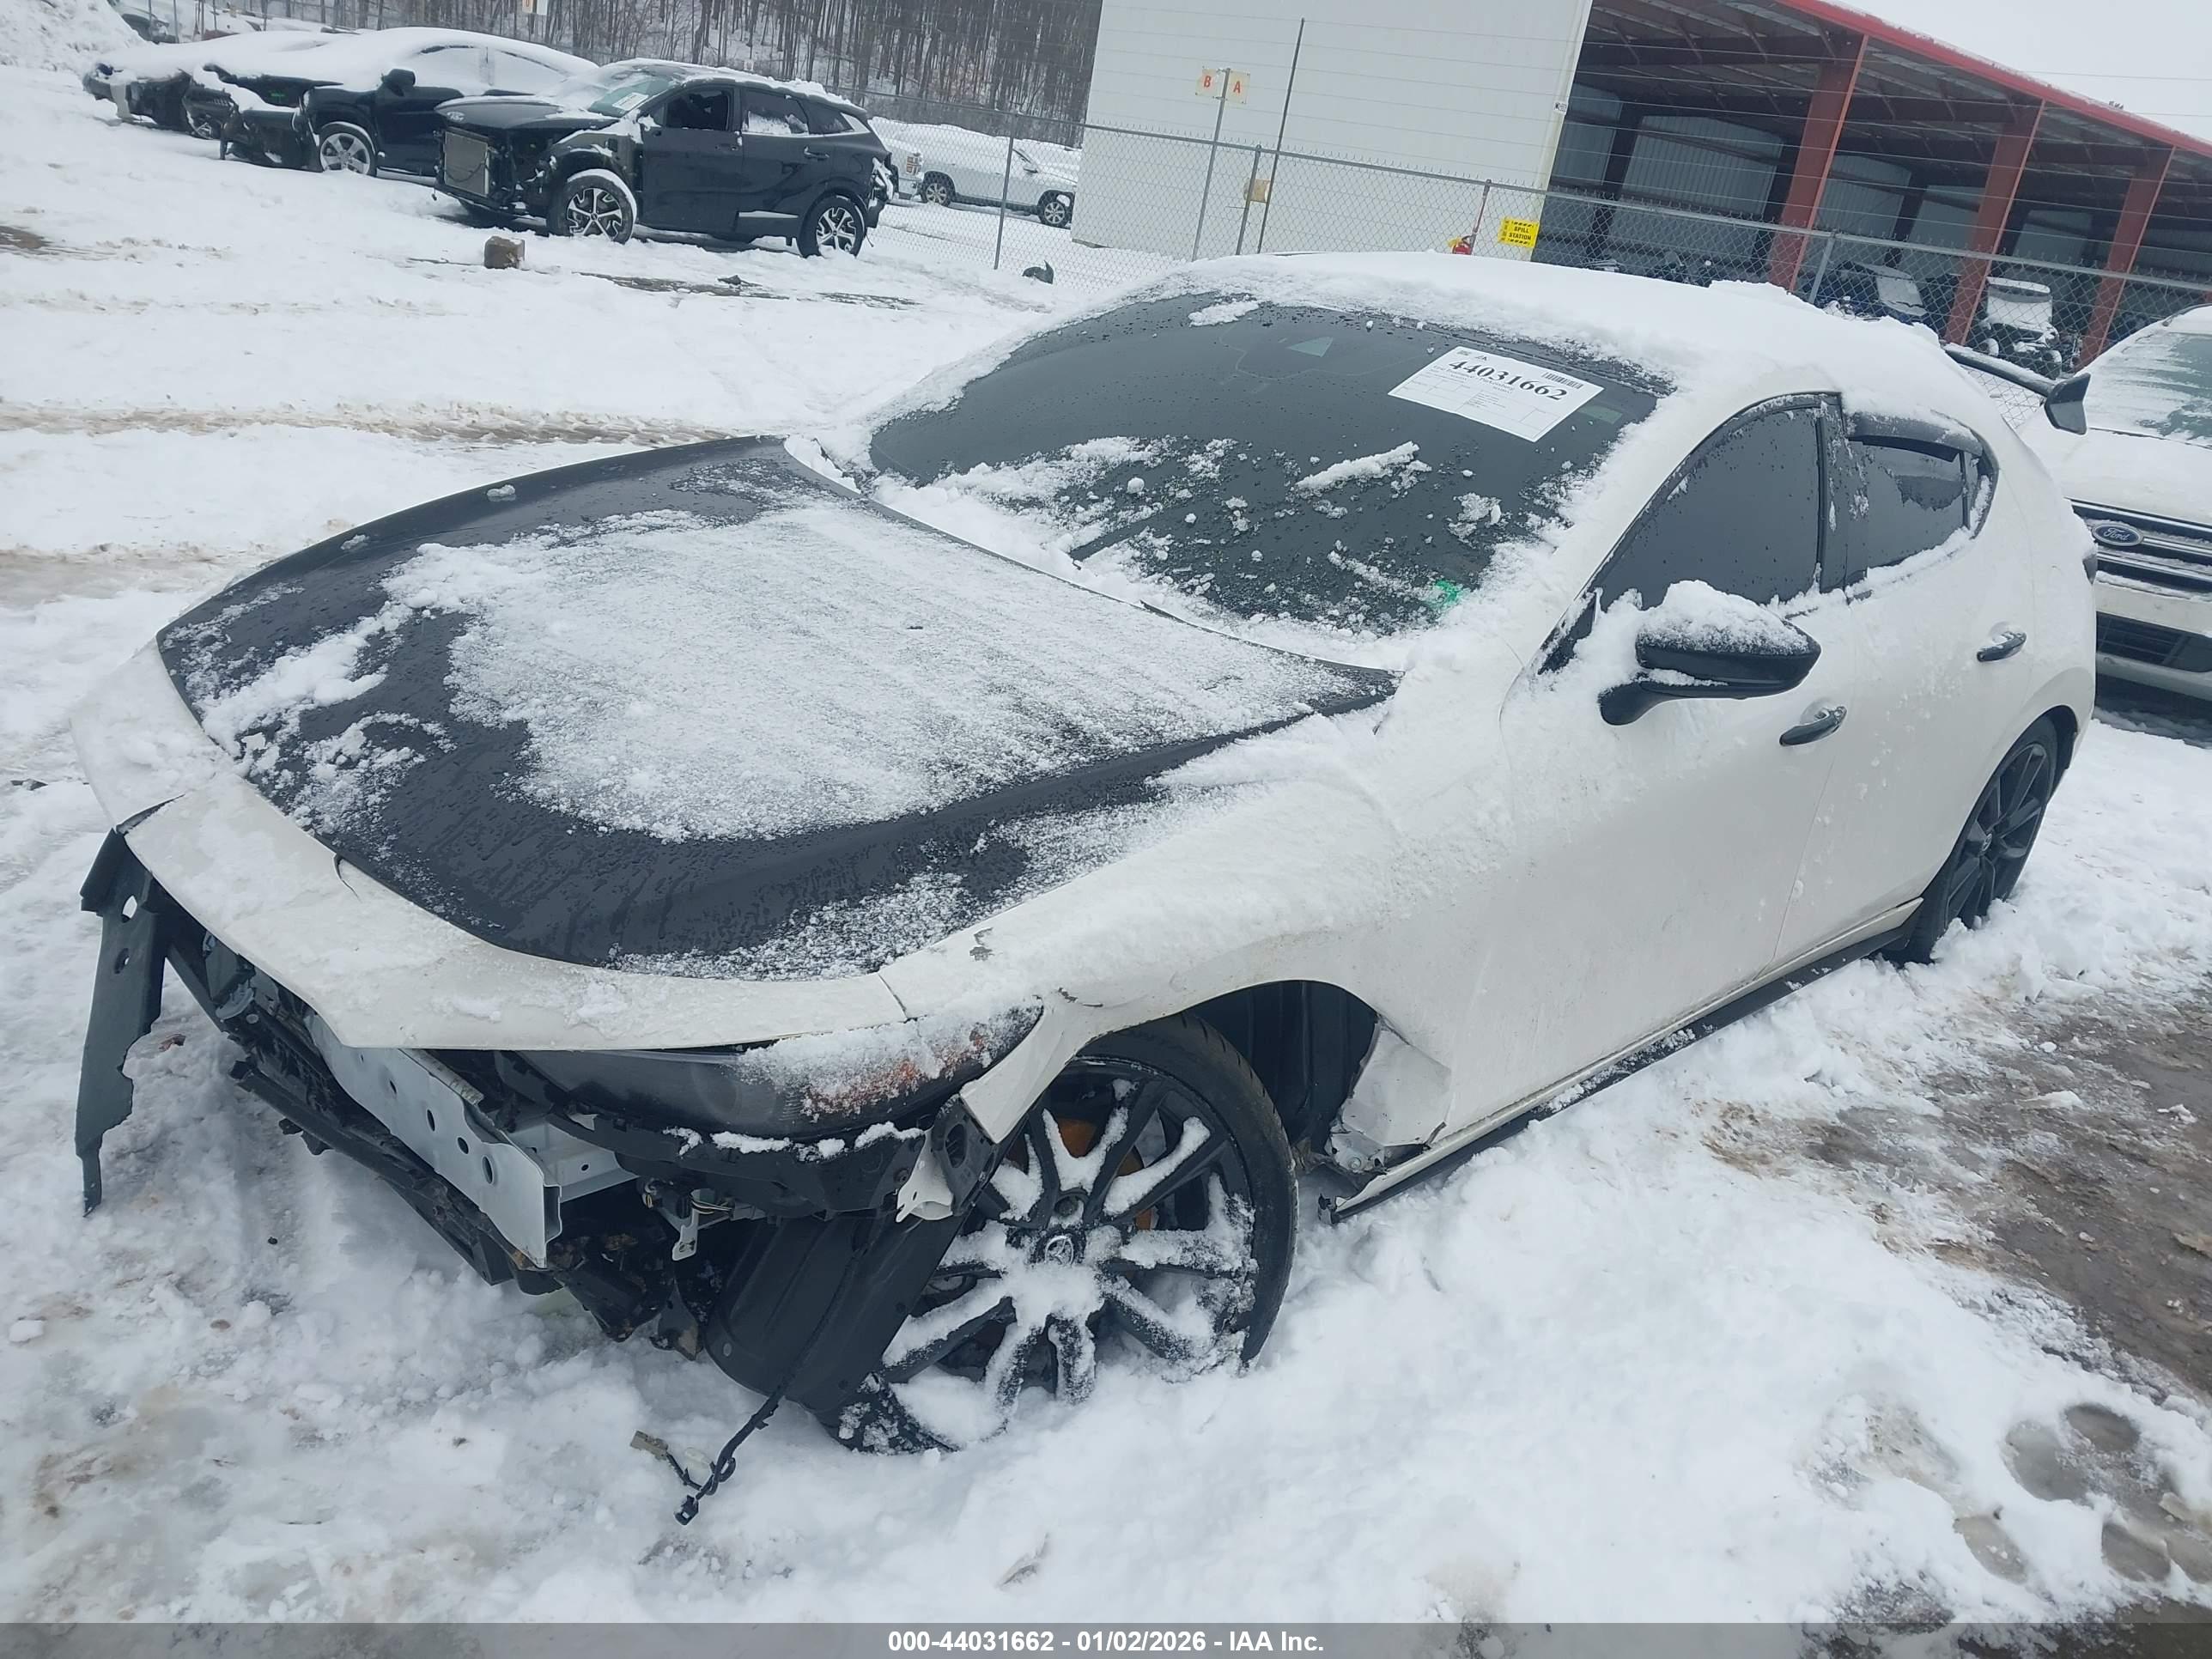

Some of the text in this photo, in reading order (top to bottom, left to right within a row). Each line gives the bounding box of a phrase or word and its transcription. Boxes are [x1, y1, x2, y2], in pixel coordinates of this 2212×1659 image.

[1204, 76, 1212, 88] B
[1233, 81, 1241, 94] A
[1509, 232, 1532, 240] STATION
[1449, 360, 1568, 400] 44031662
[2104, 528, 2130, 541] Ford
